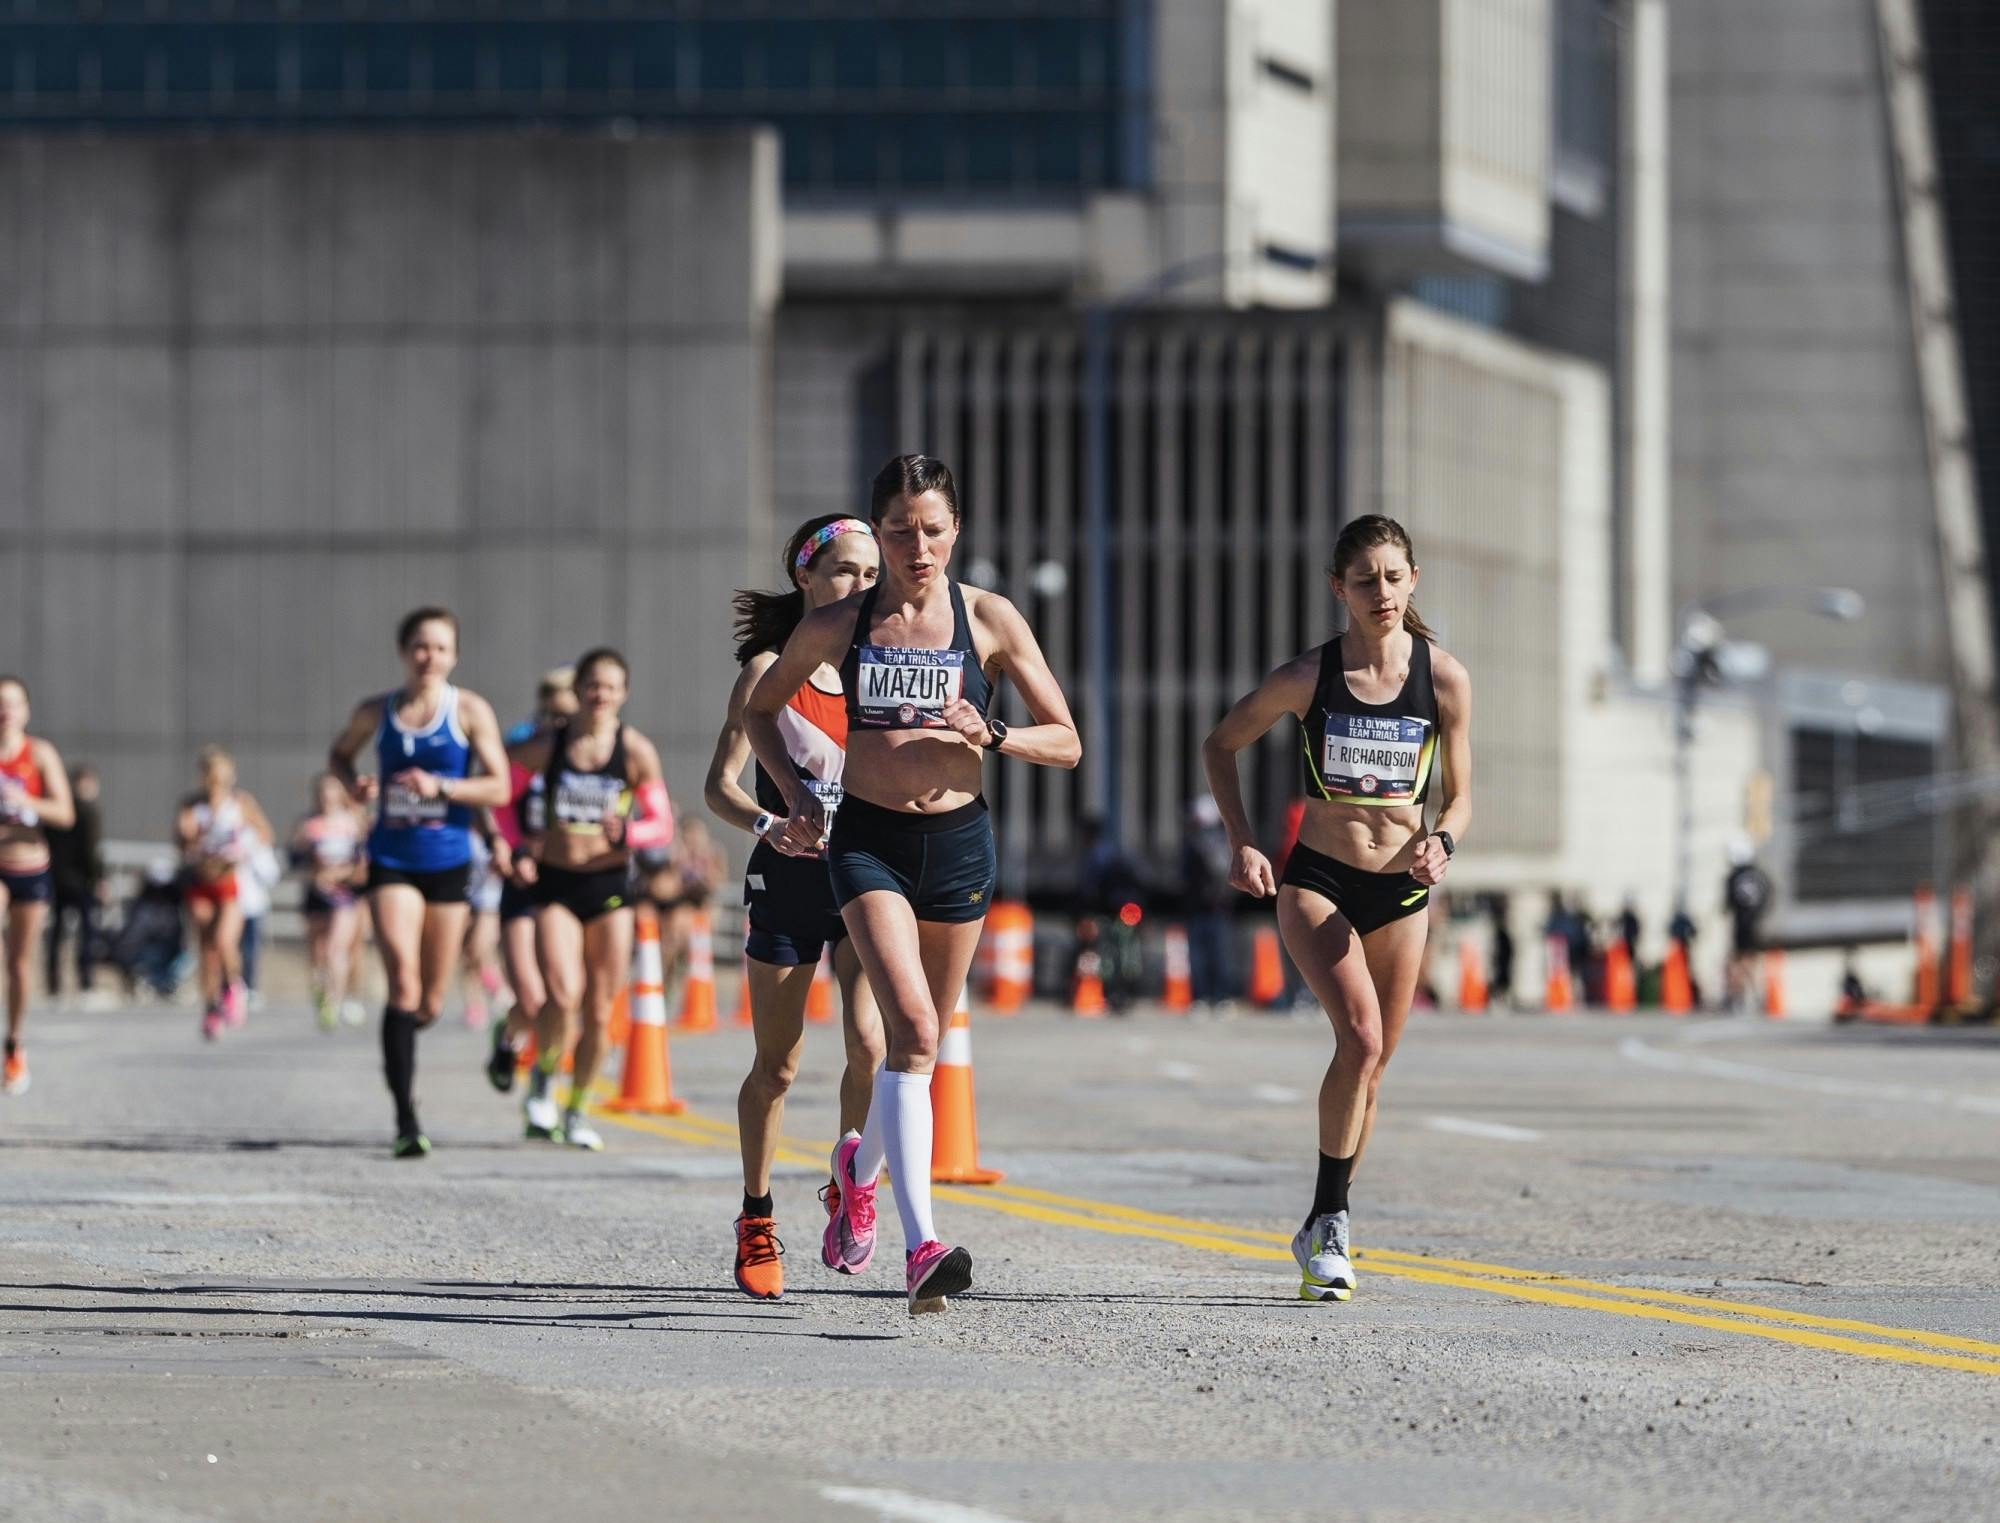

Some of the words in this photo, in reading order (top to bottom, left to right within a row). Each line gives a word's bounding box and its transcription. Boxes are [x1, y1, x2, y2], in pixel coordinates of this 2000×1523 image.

[884, 654, 906, 664] TEAM
[908, 655, 938, 665] TRIALS
[869, 667, 949, 700] MAZUR
[1349, 717, 1364, 728] U.S.
[1365, 720, 1400, 731] OLYMPIC
[1349, 728, 1370, 738] TEAM
[1372, 730, 1399, 741] TRIALS
[1328, 744, 1336, 761] T.
[1340, 746, 1416, 768] RICHARDSON
